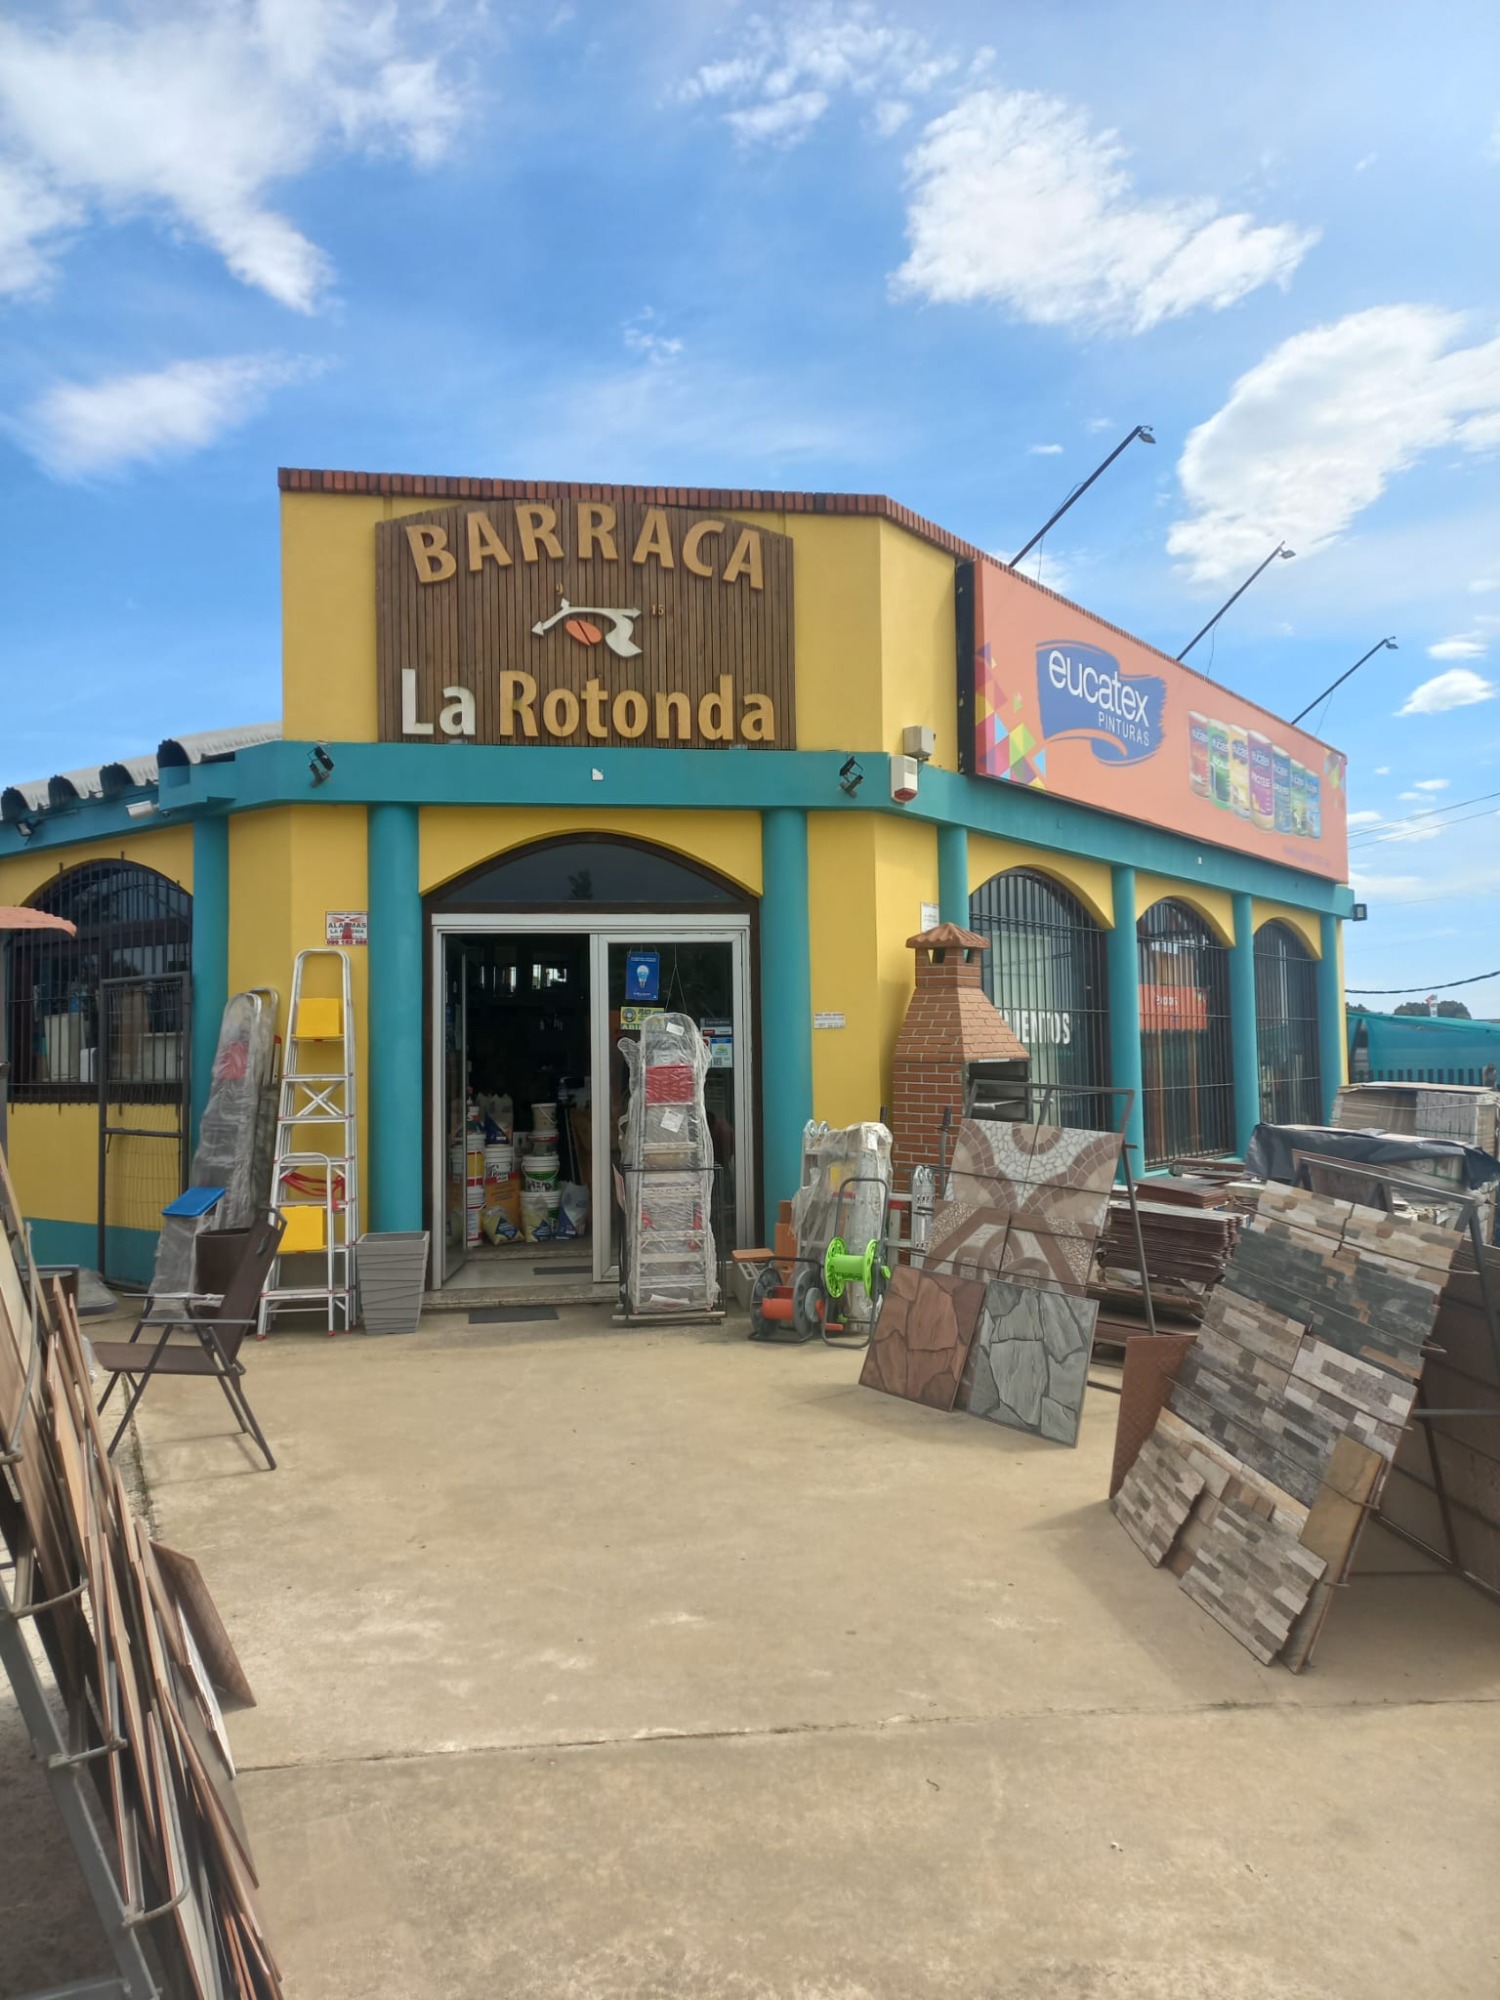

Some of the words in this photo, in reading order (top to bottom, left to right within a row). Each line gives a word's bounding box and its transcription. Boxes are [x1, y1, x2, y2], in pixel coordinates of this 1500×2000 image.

[405, 502, 764, 591] BARRACA
[555, 582, 564, 595] 9
[651, 604, 665, 616] 15
[401, 668, 476, 736] La
[499, 671, 776, 741] Rotonda
[1048, 650, 1150, 727] eucatex
[1098, 711, 1150, 747] PINTURAS
